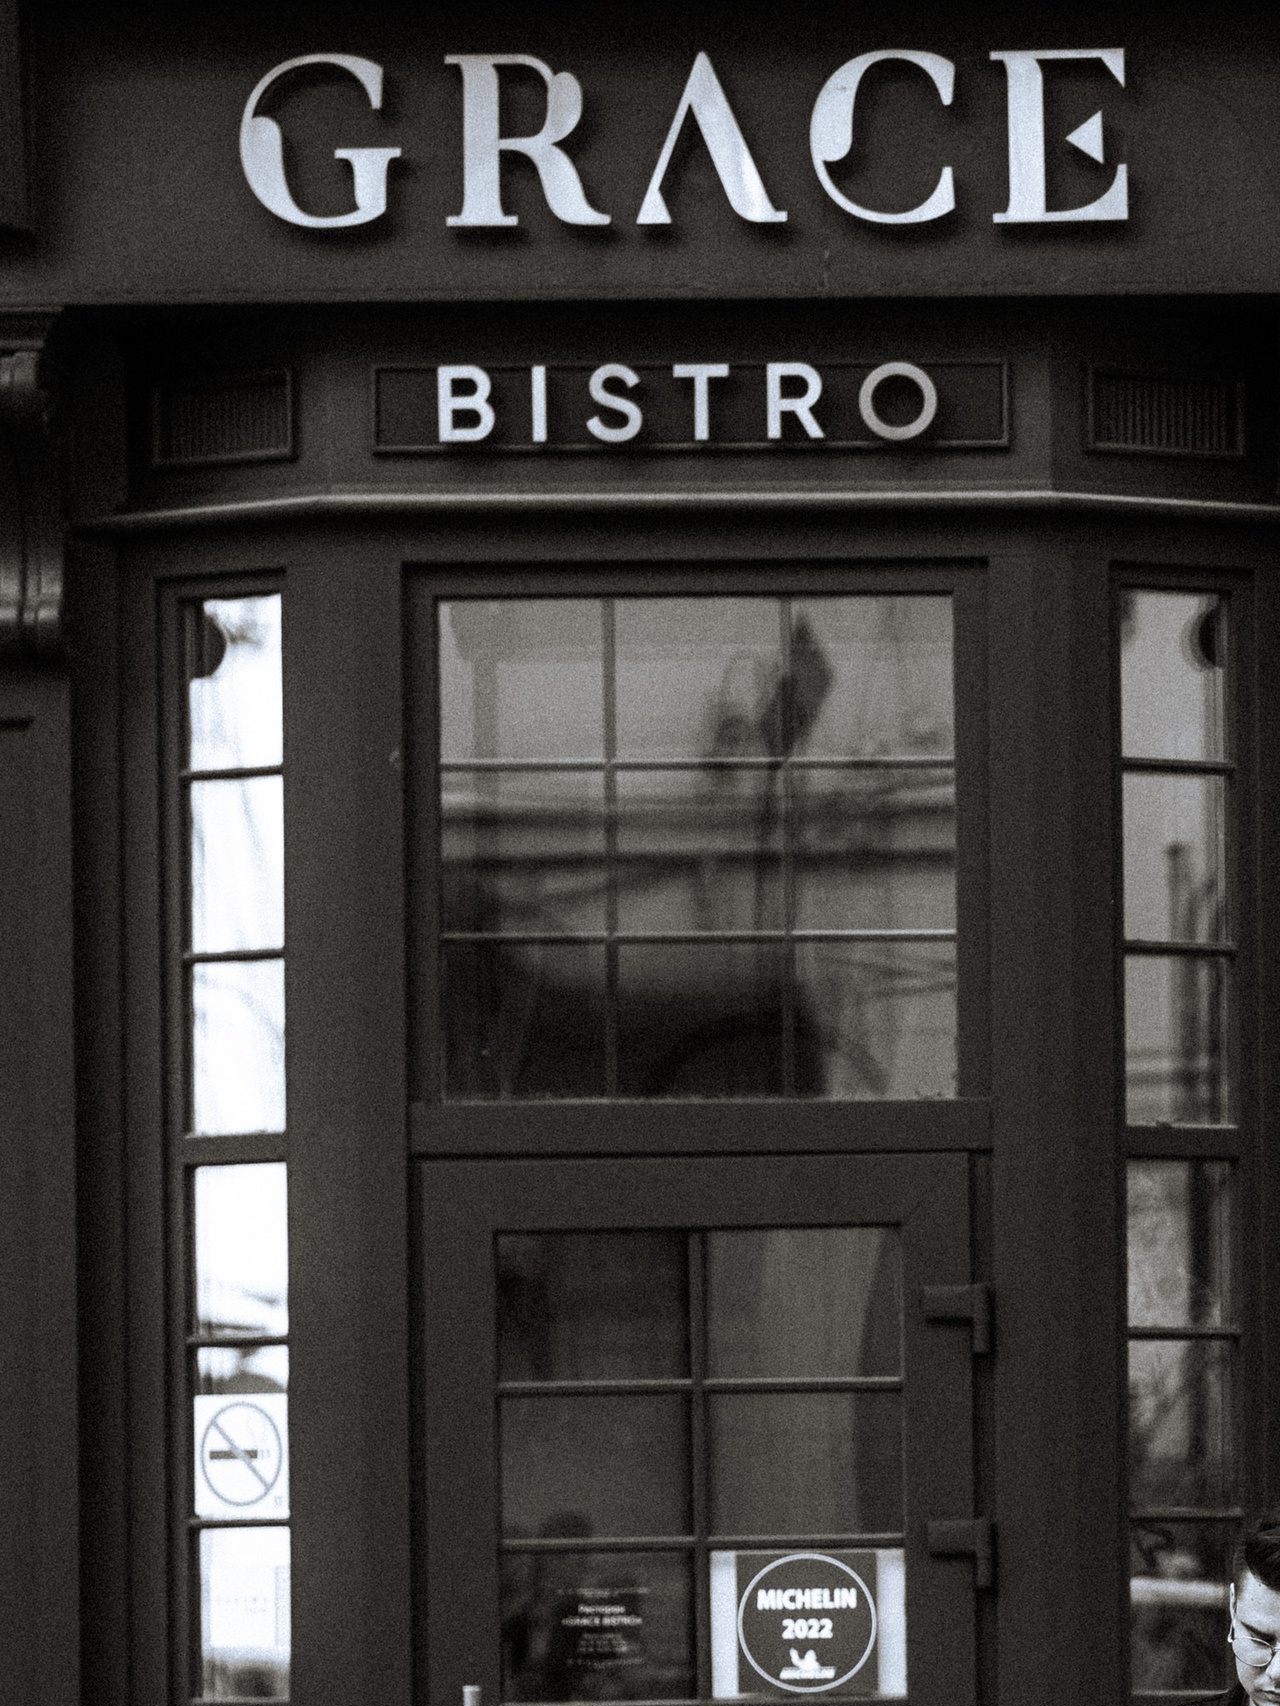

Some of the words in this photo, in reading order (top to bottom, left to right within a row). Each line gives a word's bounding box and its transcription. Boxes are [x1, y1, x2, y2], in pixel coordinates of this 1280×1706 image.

[240, 49, 1128, 227] GRACE
[438, 363, 936, 441] BISTRO
[757, 1588, 857, 1610] MICHELIN
[782, 1618, 833, 1640] 2022
